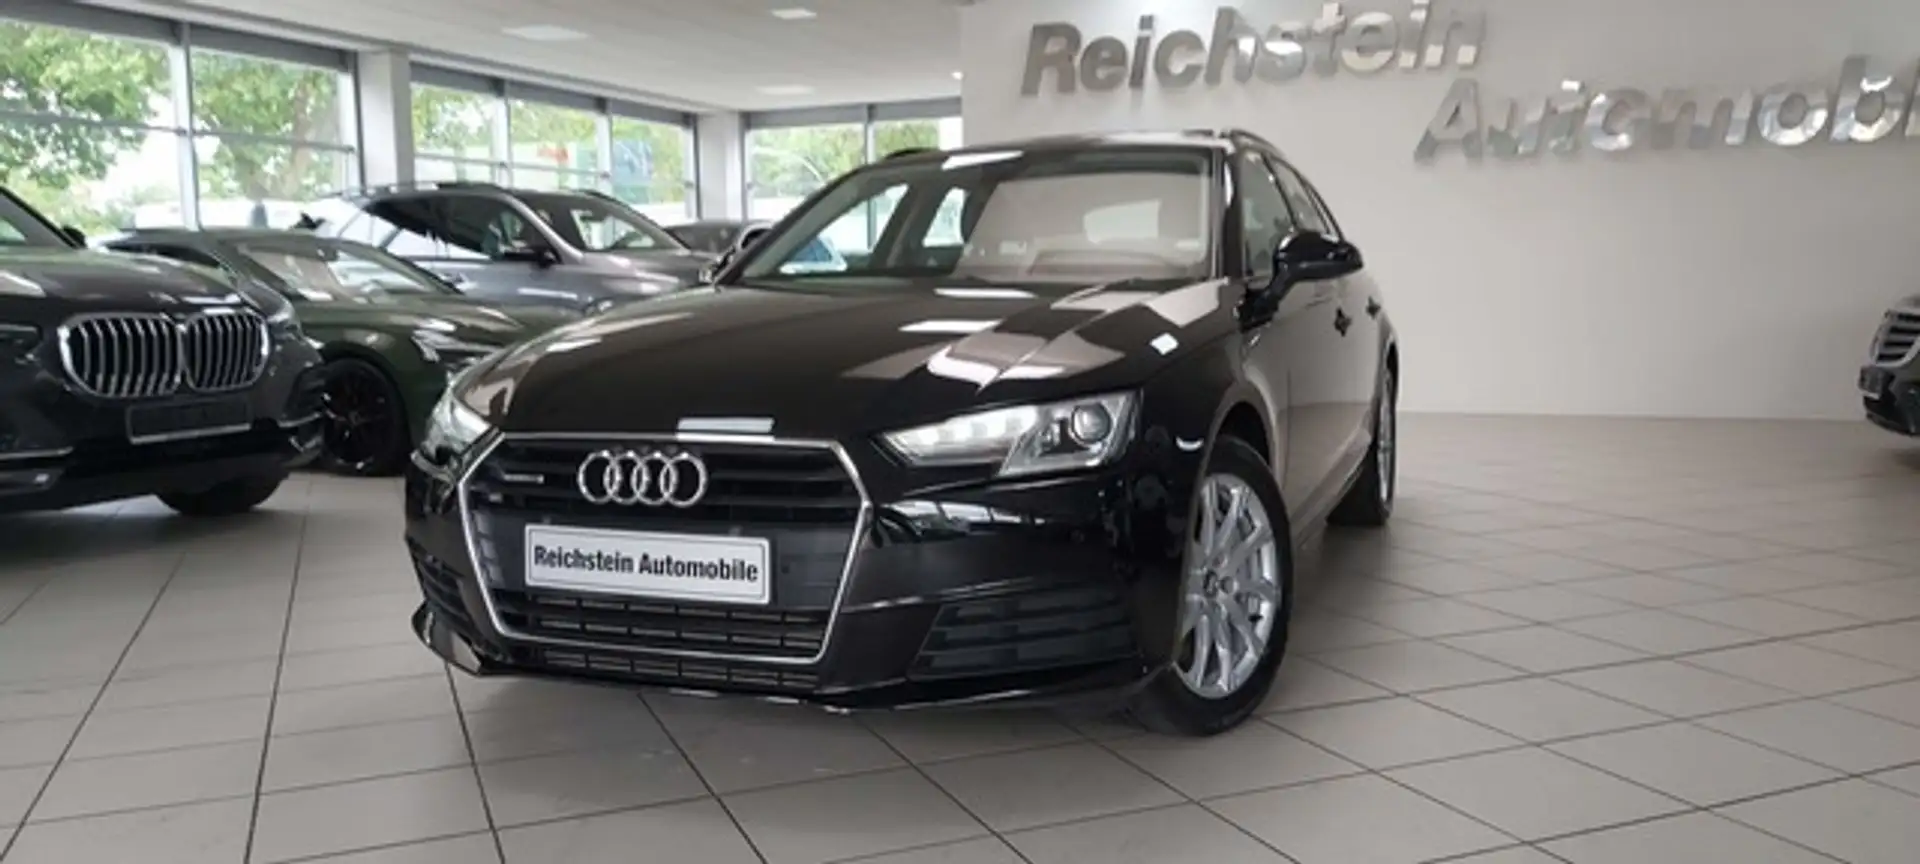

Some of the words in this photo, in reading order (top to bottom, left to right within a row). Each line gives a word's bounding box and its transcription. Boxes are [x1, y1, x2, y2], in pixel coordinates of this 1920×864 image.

[1021, 0, 1484, 95] Reichstein
[534, 545, 634, 573] Reichstein
[639, 552, 758, 582] Automobile
